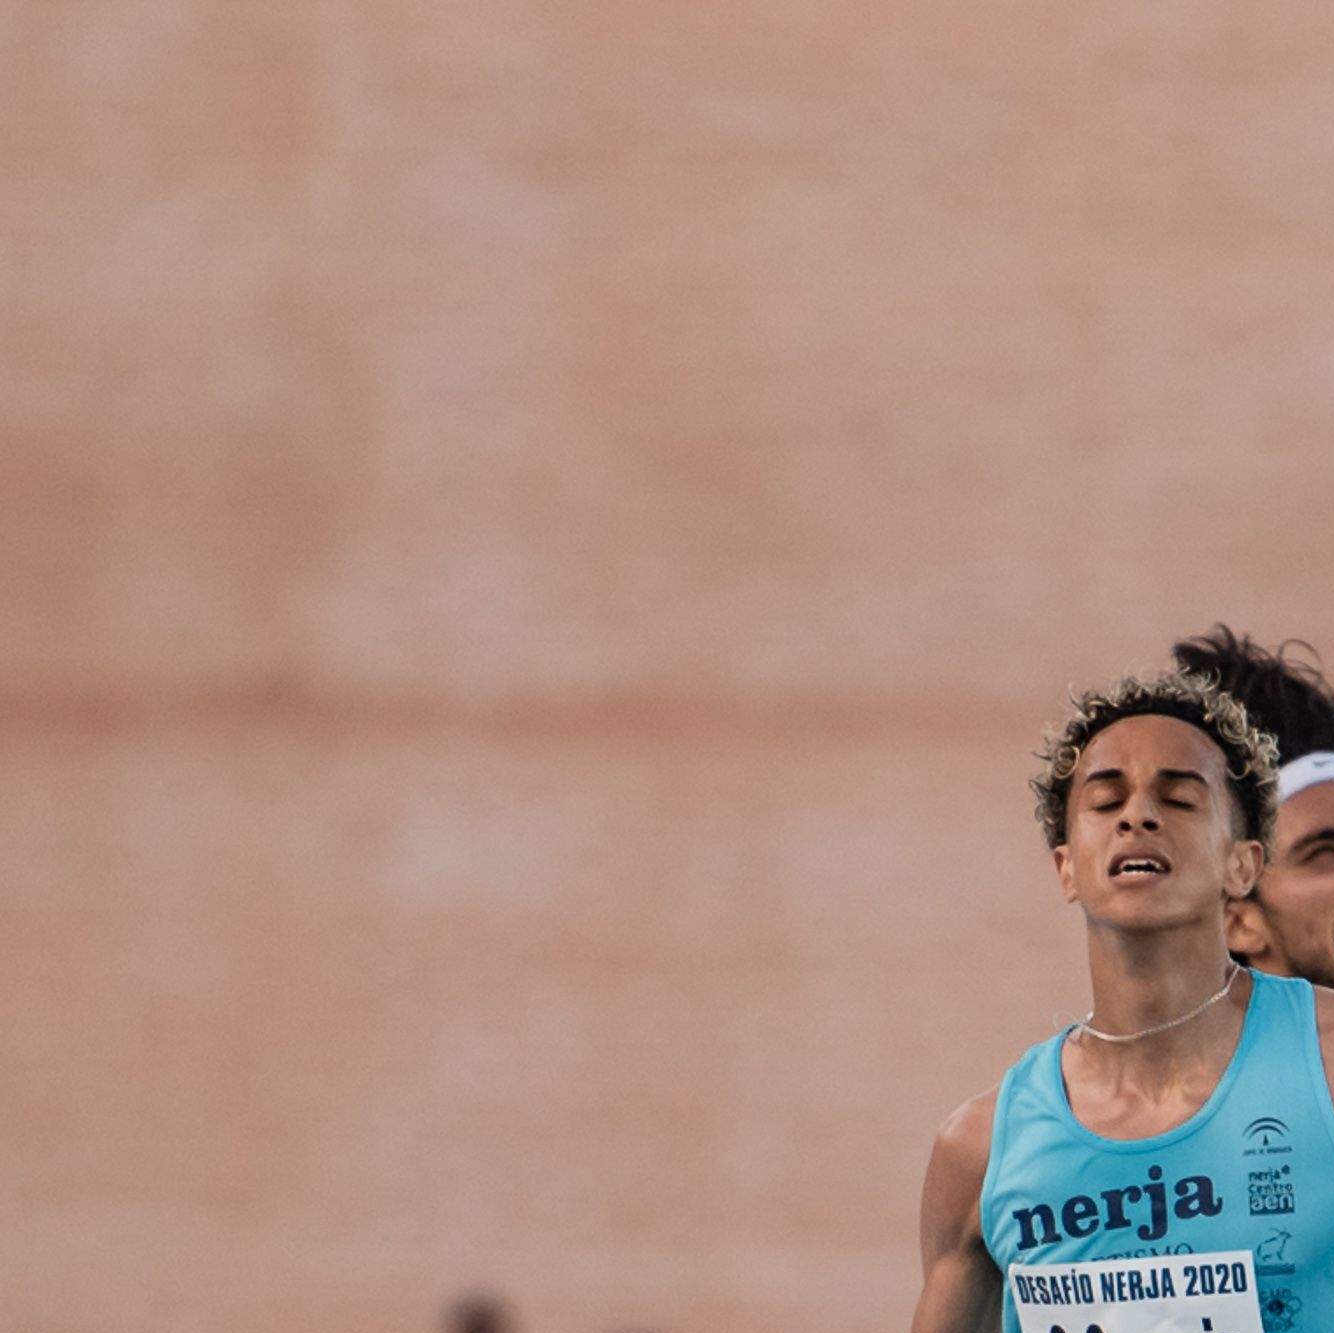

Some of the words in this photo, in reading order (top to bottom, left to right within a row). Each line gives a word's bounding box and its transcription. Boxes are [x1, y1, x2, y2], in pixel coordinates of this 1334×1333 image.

[1013, 1165, 1222, 1250] nerja
[1015, 1269, 1094, 1305] DESAFÍO
[1100, 1267, 1176, 1303] NERJA
[1183, 1262, 1248, 1297] 2020
